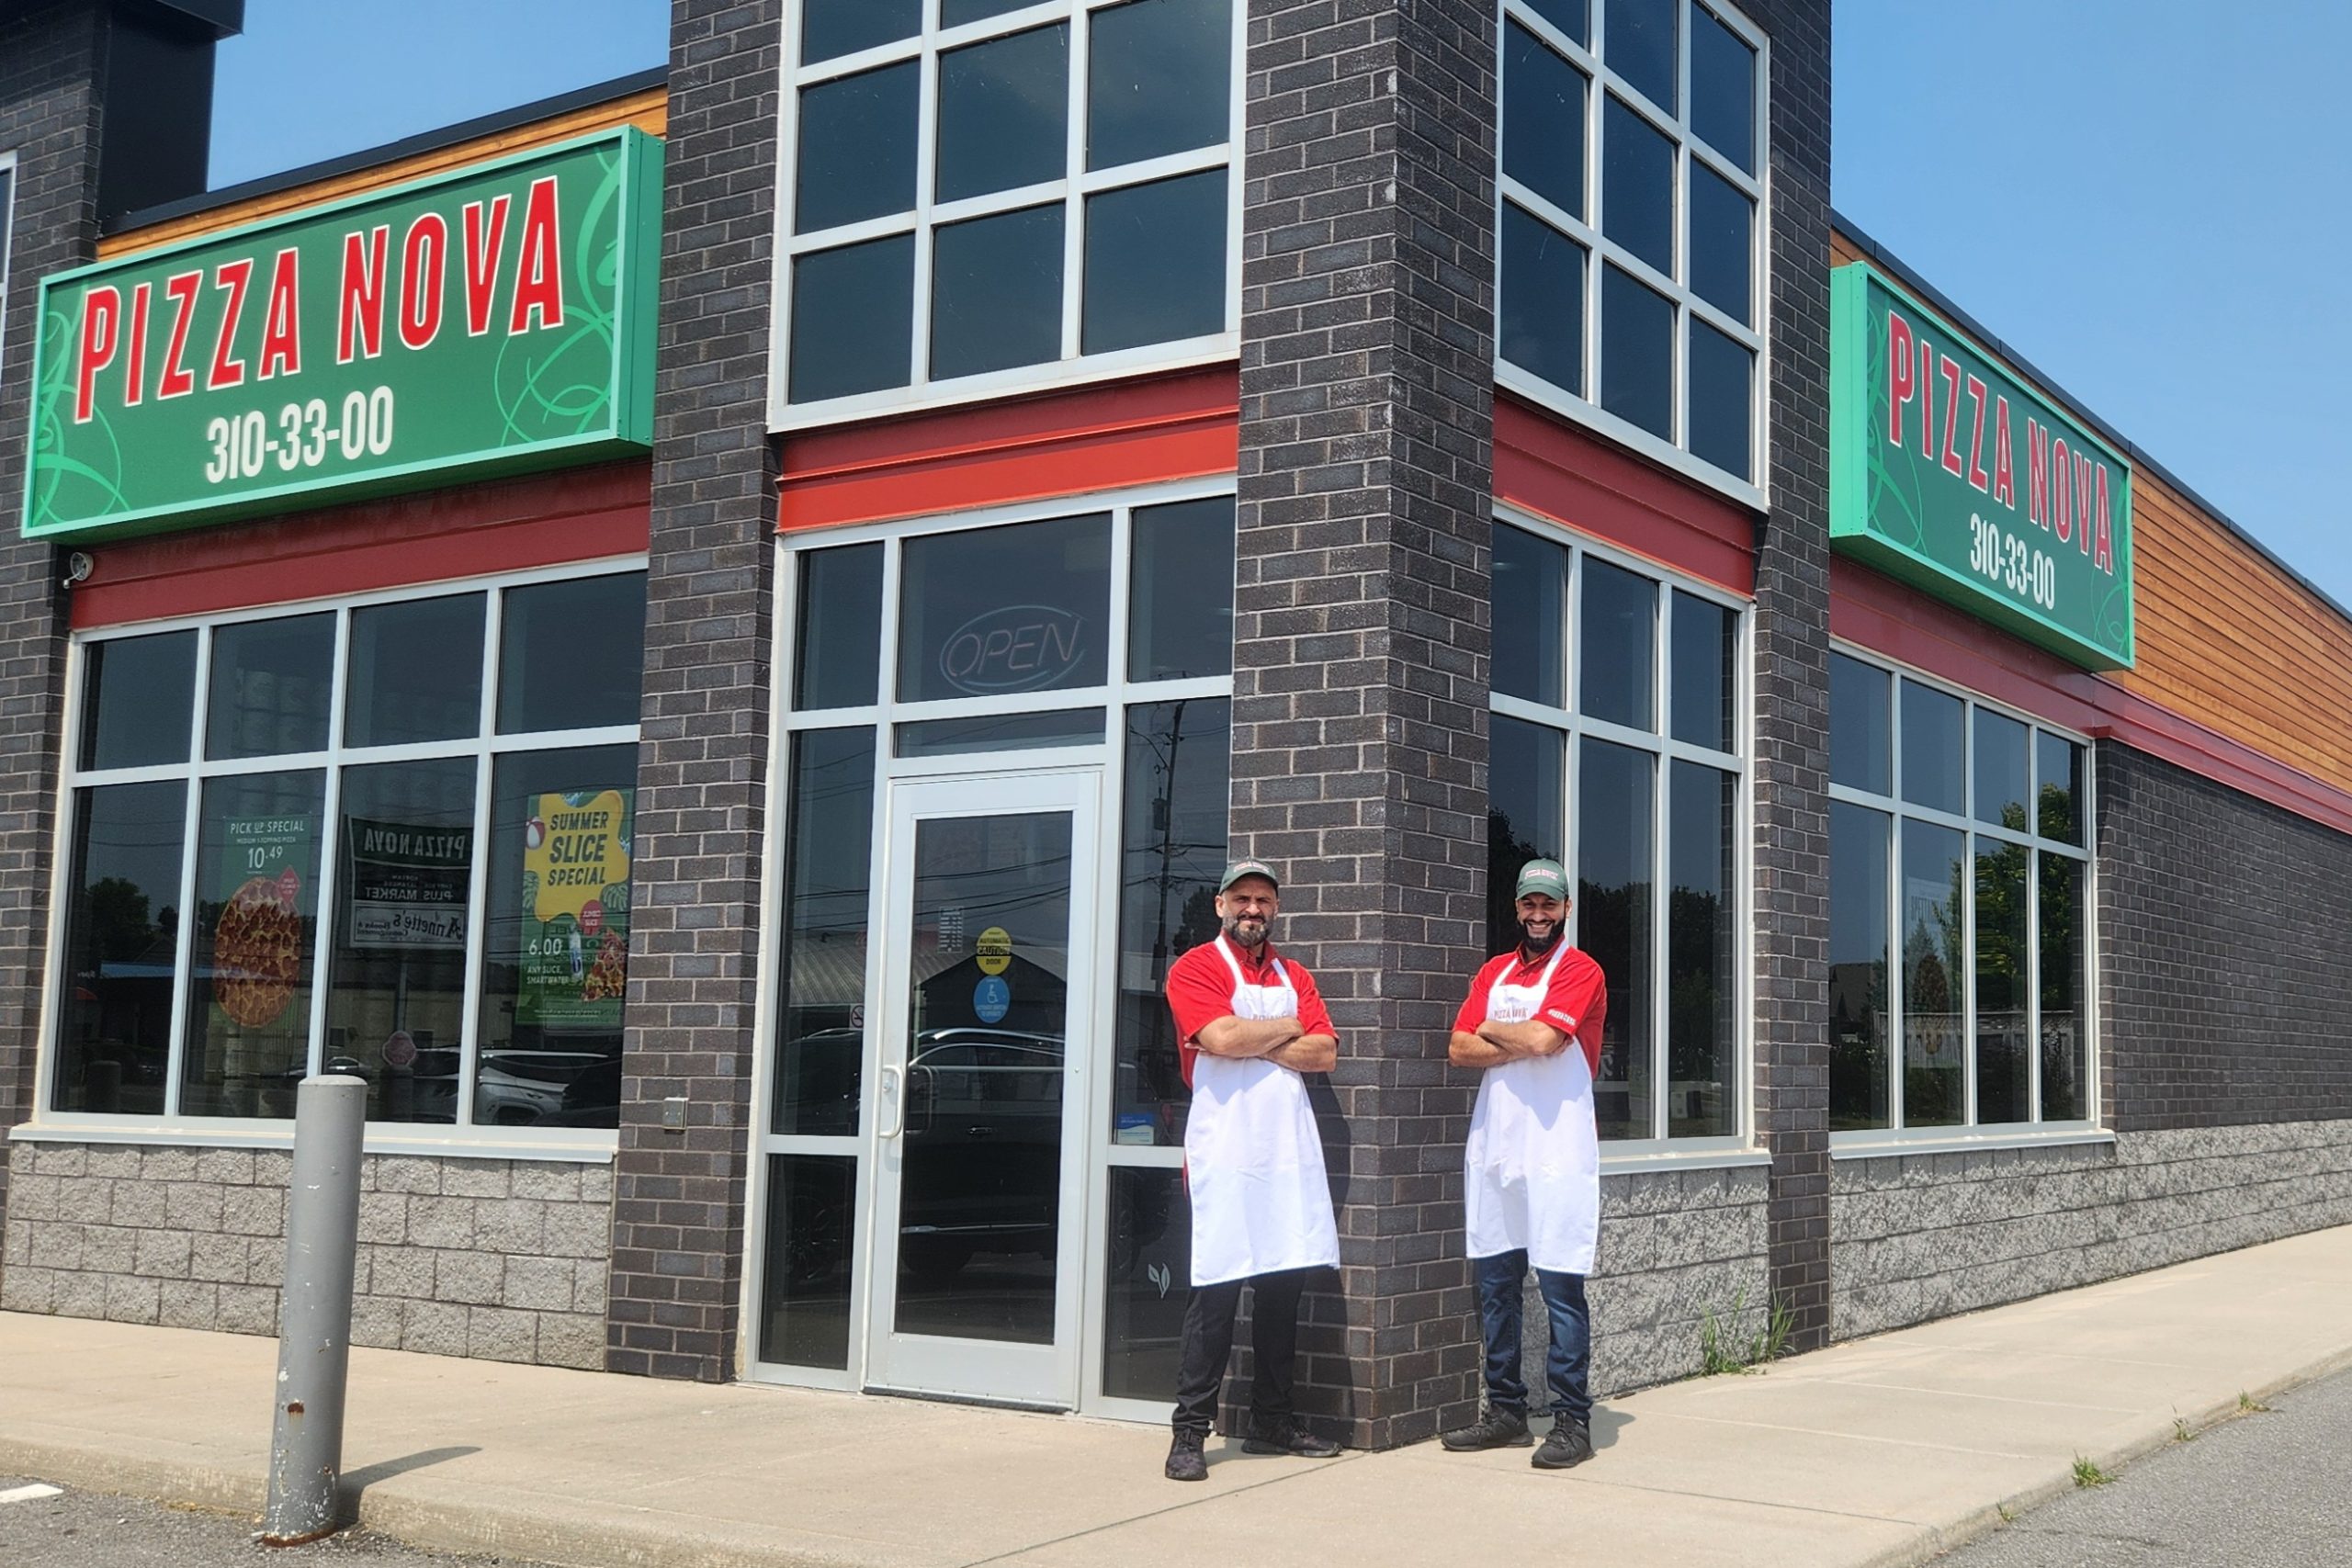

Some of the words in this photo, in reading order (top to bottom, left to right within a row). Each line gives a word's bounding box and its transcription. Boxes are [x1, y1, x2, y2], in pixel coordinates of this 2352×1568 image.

[74, 246, 301, 423] PIZZA
[336, 175, 564, 365] NOVA
[206, 385, 394, 483] 310-33-00
[1888, 310, 2015, 511] PIZZA
[2028, 416, 2113, 576] NOVA
[1969, 513, 2055, 610] 310-33-00
[947, 619, 1081, 678] OPEN
[230, 822, 253, 834] PICK
[254, 822, 264, 833] UP
[266, 820, 304, 832] SPECIAL
[549, 811, 609, 831] SUMMER
[248, 846, 283, 868] 10.49
[548, 834, 608, 863] SLICE
[547, 867, 606, 886] SPECIAL
[528, 938, 562, 955] 6.00
[977, 946, 1011, 955] CAUTION
[526, 965, 541, 974] ANY
